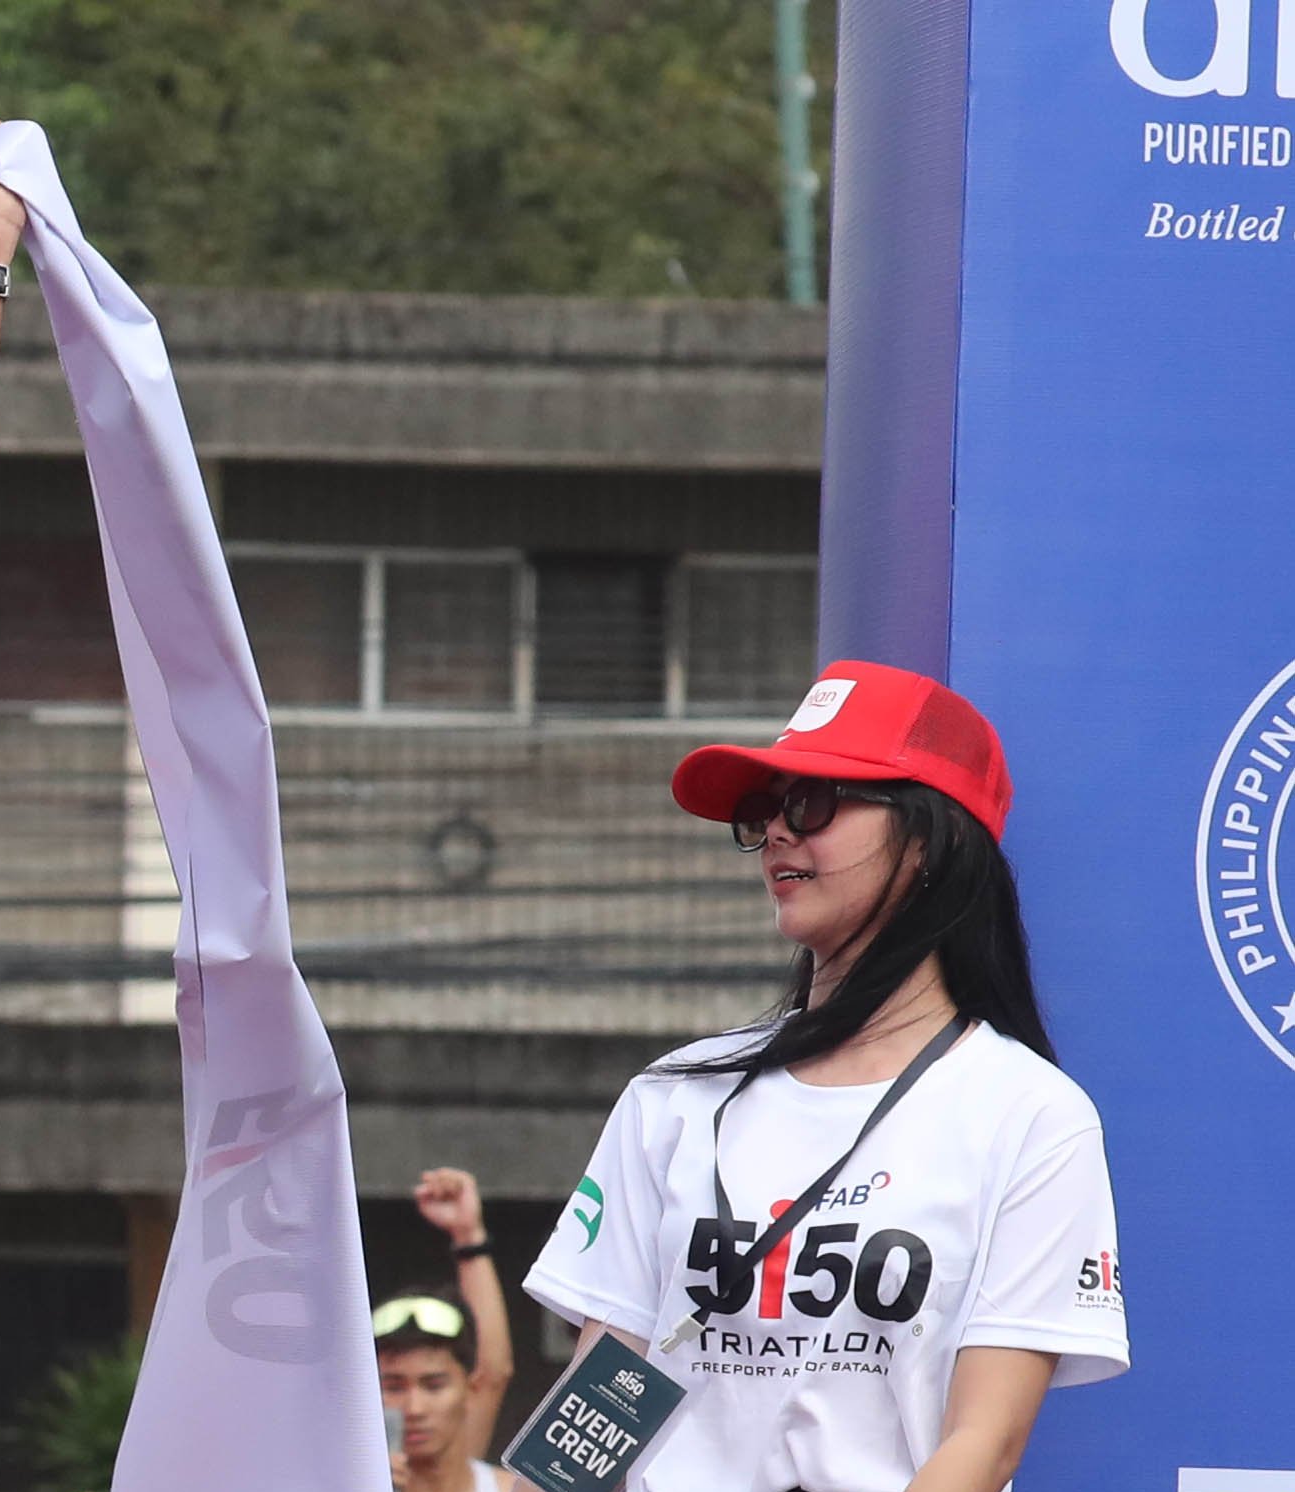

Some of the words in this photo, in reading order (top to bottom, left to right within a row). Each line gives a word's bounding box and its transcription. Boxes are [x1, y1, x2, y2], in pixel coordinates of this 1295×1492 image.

[1144, 122, 1291, 167] PURIFIED
[1145, 203, 1285, 242] Bottled
[700, 1326, 895, 1360] TRIATLON
[691, 1361, 776, 1377] FREEPORT
[805, 1361, 826, 1373] OF
[559, 1392, 638, 1458] EVENT
[545, 1419, 617, 1480] CREW
